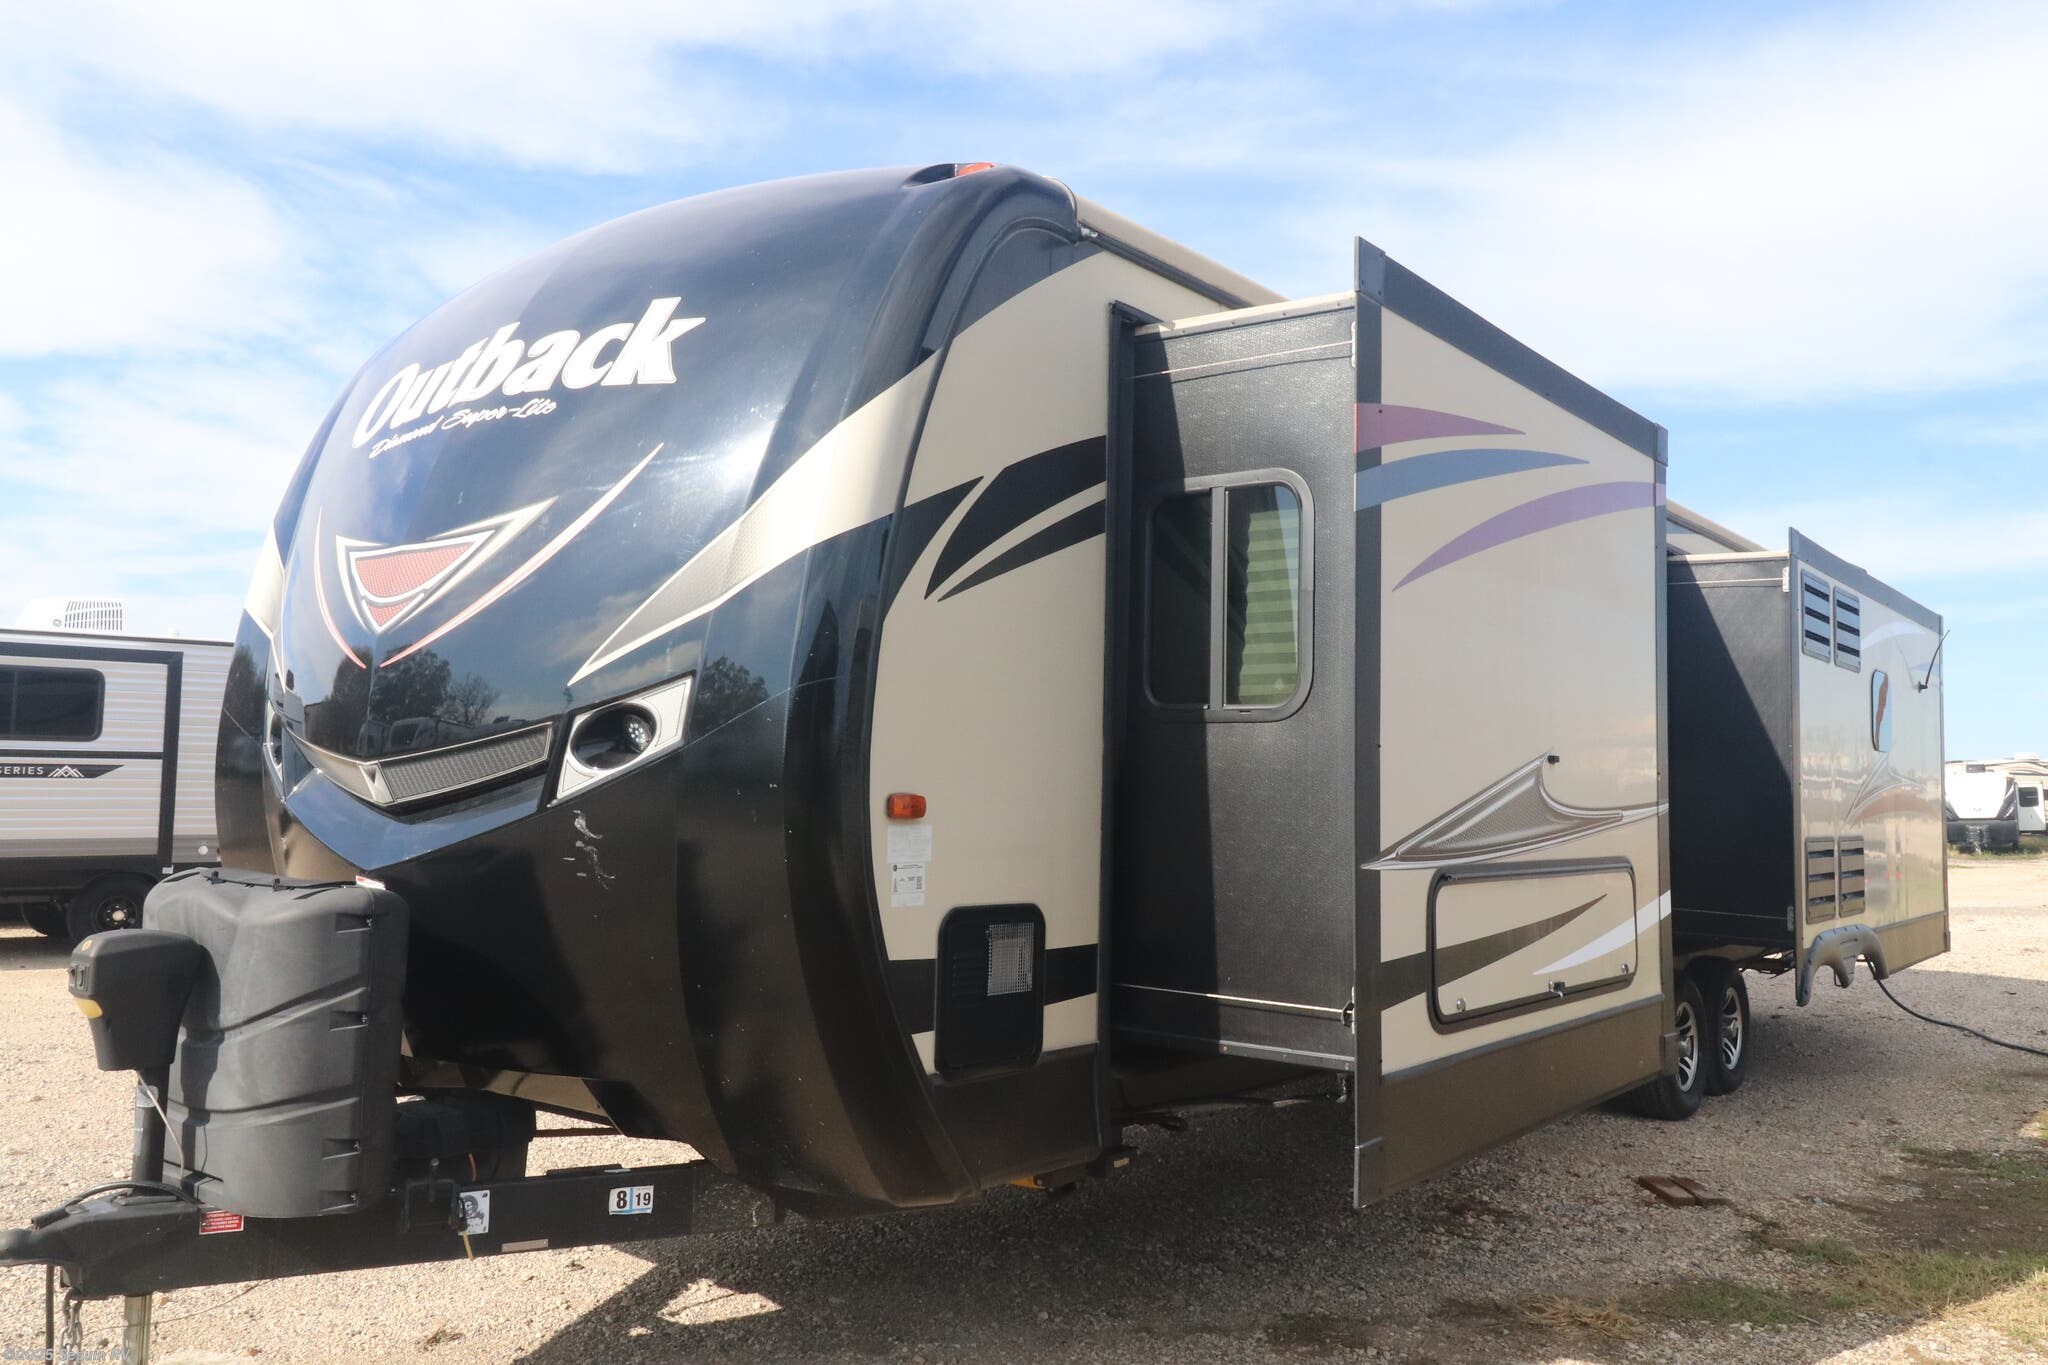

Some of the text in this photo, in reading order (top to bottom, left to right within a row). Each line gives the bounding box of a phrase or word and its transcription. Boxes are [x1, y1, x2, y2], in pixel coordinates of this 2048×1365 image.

[351, 296, 706, 449] Outback
[368, 397, 558, 460] Diamond Super-Lite
[0, 766, 44, 775] ERIES
[616, 1190, 651, 1209] 8 19
